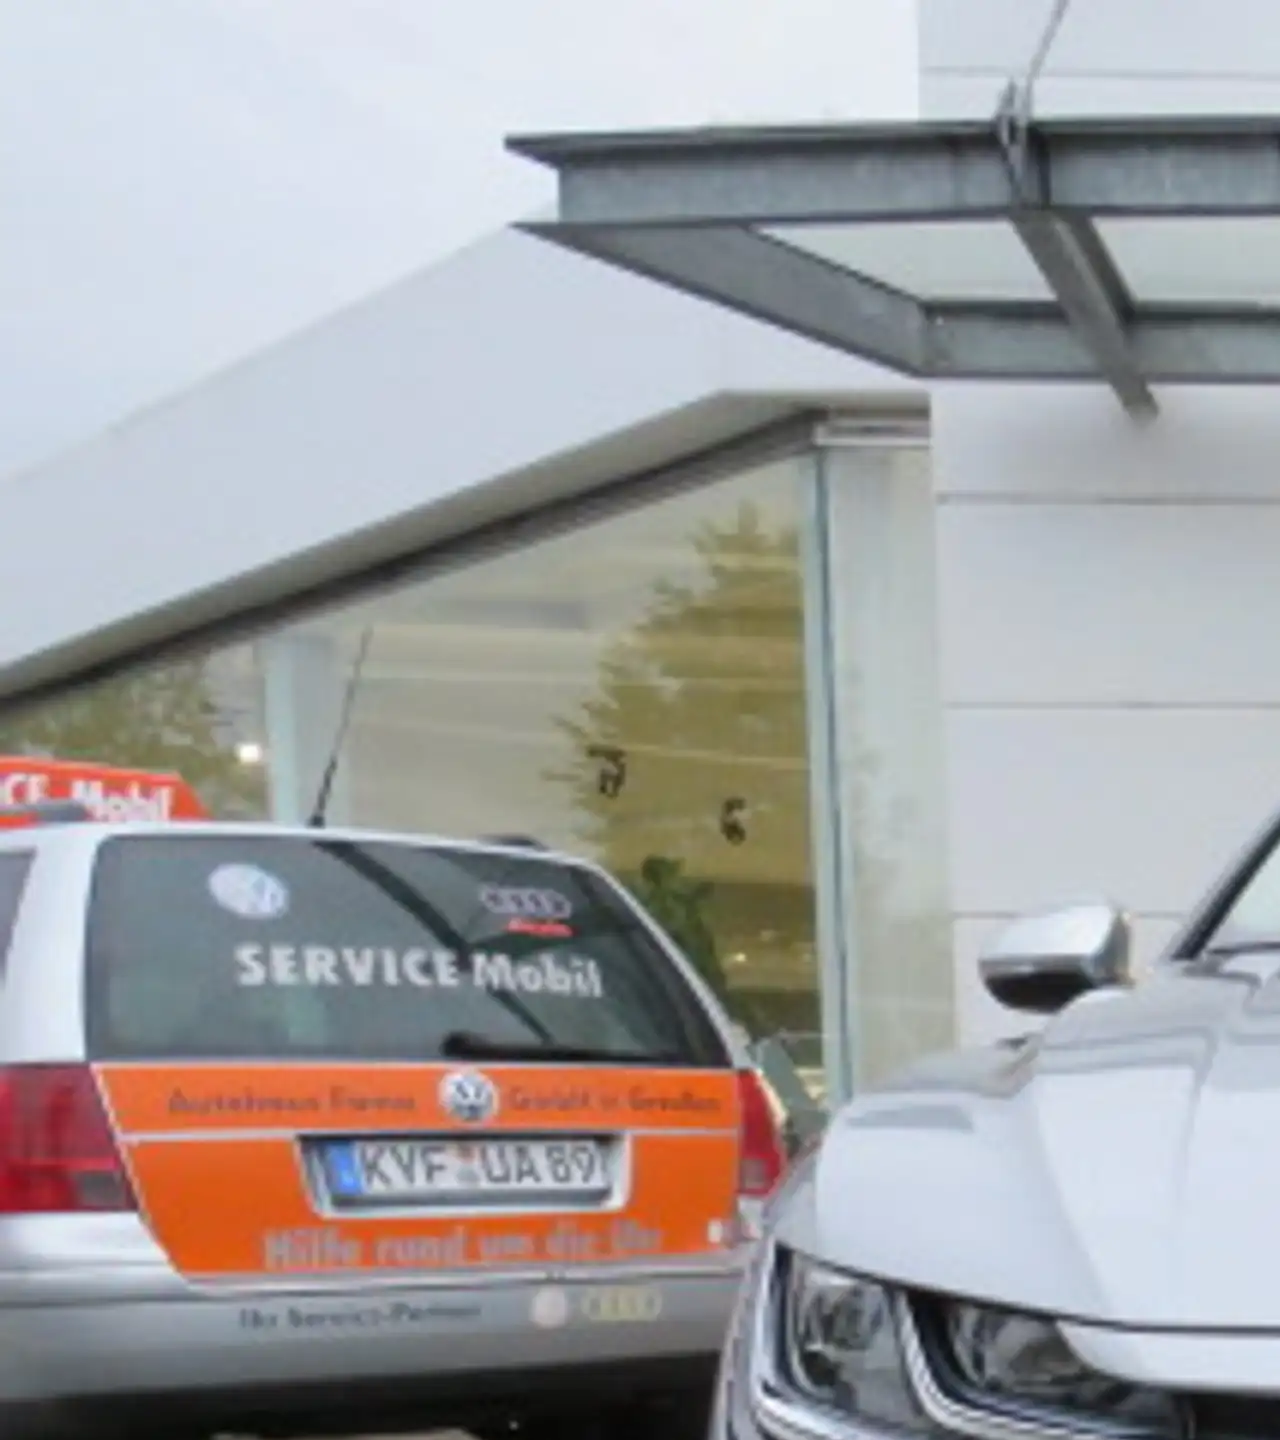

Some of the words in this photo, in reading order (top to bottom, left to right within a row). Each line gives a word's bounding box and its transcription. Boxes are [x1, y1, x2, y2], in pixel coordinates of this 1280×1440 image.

[235, 944, 459, 987] SERVICE
[473, 952, 603, 998] Mobil
[362, 1143, 449, 1186] KVF
[482, 1142, 542, 1185] UA
[546, 1140, 598, 1184] 89
[265, 1229, 362, 1272] Hilfe
[376, 1225, 472, 1268] rund
[478, 1231, 535, 1266] um
